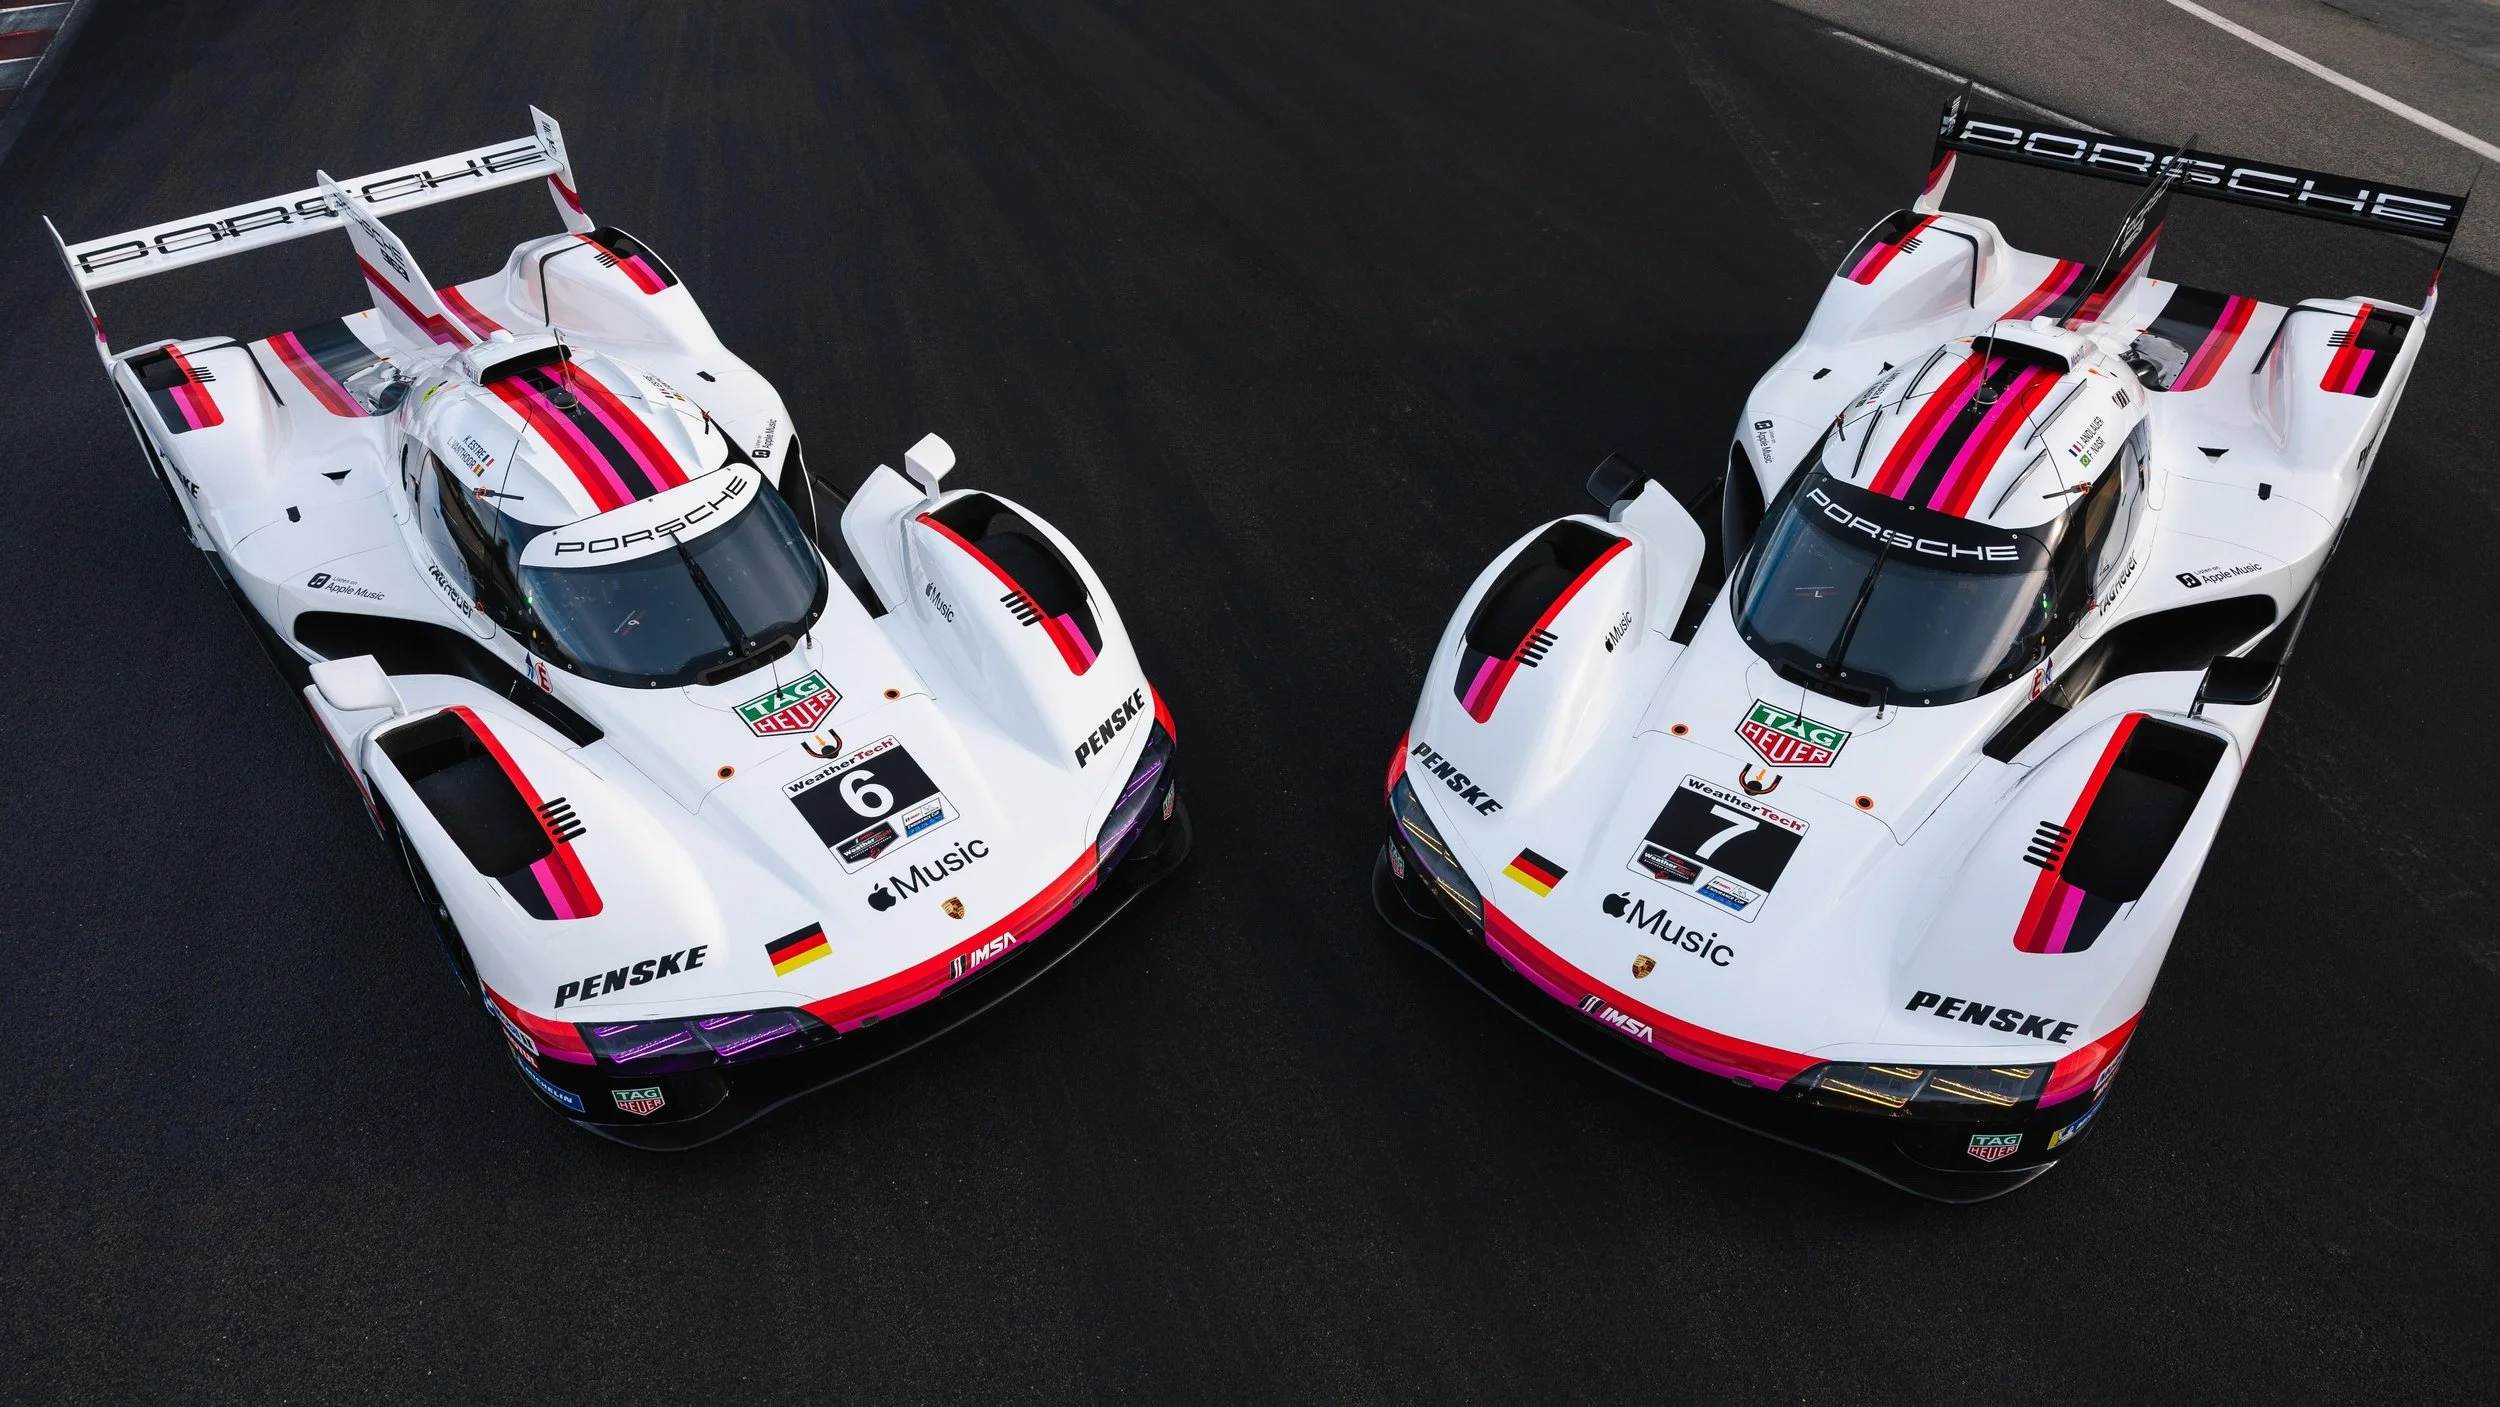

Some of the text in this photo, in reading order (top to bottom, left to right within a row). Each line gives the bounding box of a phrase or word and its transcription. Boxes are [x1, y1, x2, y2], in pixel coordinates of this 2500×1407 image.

[1959, 120, 2451, 227] PORSCHE
[77, 144, 547, 274] PORSCHE
[450, 441, 477, 469] VANTHOOR
[468, 440, 487, 459] ESTRE
[2090, 436, 2106, 454] NASR
[555, 476, 748, 557] PORSCHE
[1806, 487, 2020, 561] PORSCHE
[324, 582, 385, 600] Apple Music
[2201, 562, 2263, 584] Apple Music
[930, 585, 955, 623] Music
[1610, 611, 1633, 645] Music
[744, 675, 819, 718] TAG
[755, 691, 834, 734] HEUER
[1073, 688, 1146, 768] PENSKE
[1743, 721, 1828, 764] HEUER
[1758, 707, 1838, 748] TAG
[788, 739, 893, 793] WeatherTech
[1412, 741, 1504, 817] PENSKE
[839, 769, 894, 818] 6
[1688, 778, 1806, 832] WeatherTech
[1695, 804, 1760, 860] 7
[889, 838, 990, 900] Music
[970, 931, 1017, 969] IMSA
[1626, 899, 1735, 967] Music
[554, 944, 708, 1009] PENSKE
[1600, 1006, 1654, 1044] IMSA
[1904, 990, 2079, 1045] PENSKE
[525, 1066, 573, 1104] MICHELIN
[615, 1089, 658, 1100] TAG
[619, 1100, 663, 1114] HEUER
[1969, 1145, 2017, 1161] HEUER
[1974, 1135, 2018, 1146] TAG
